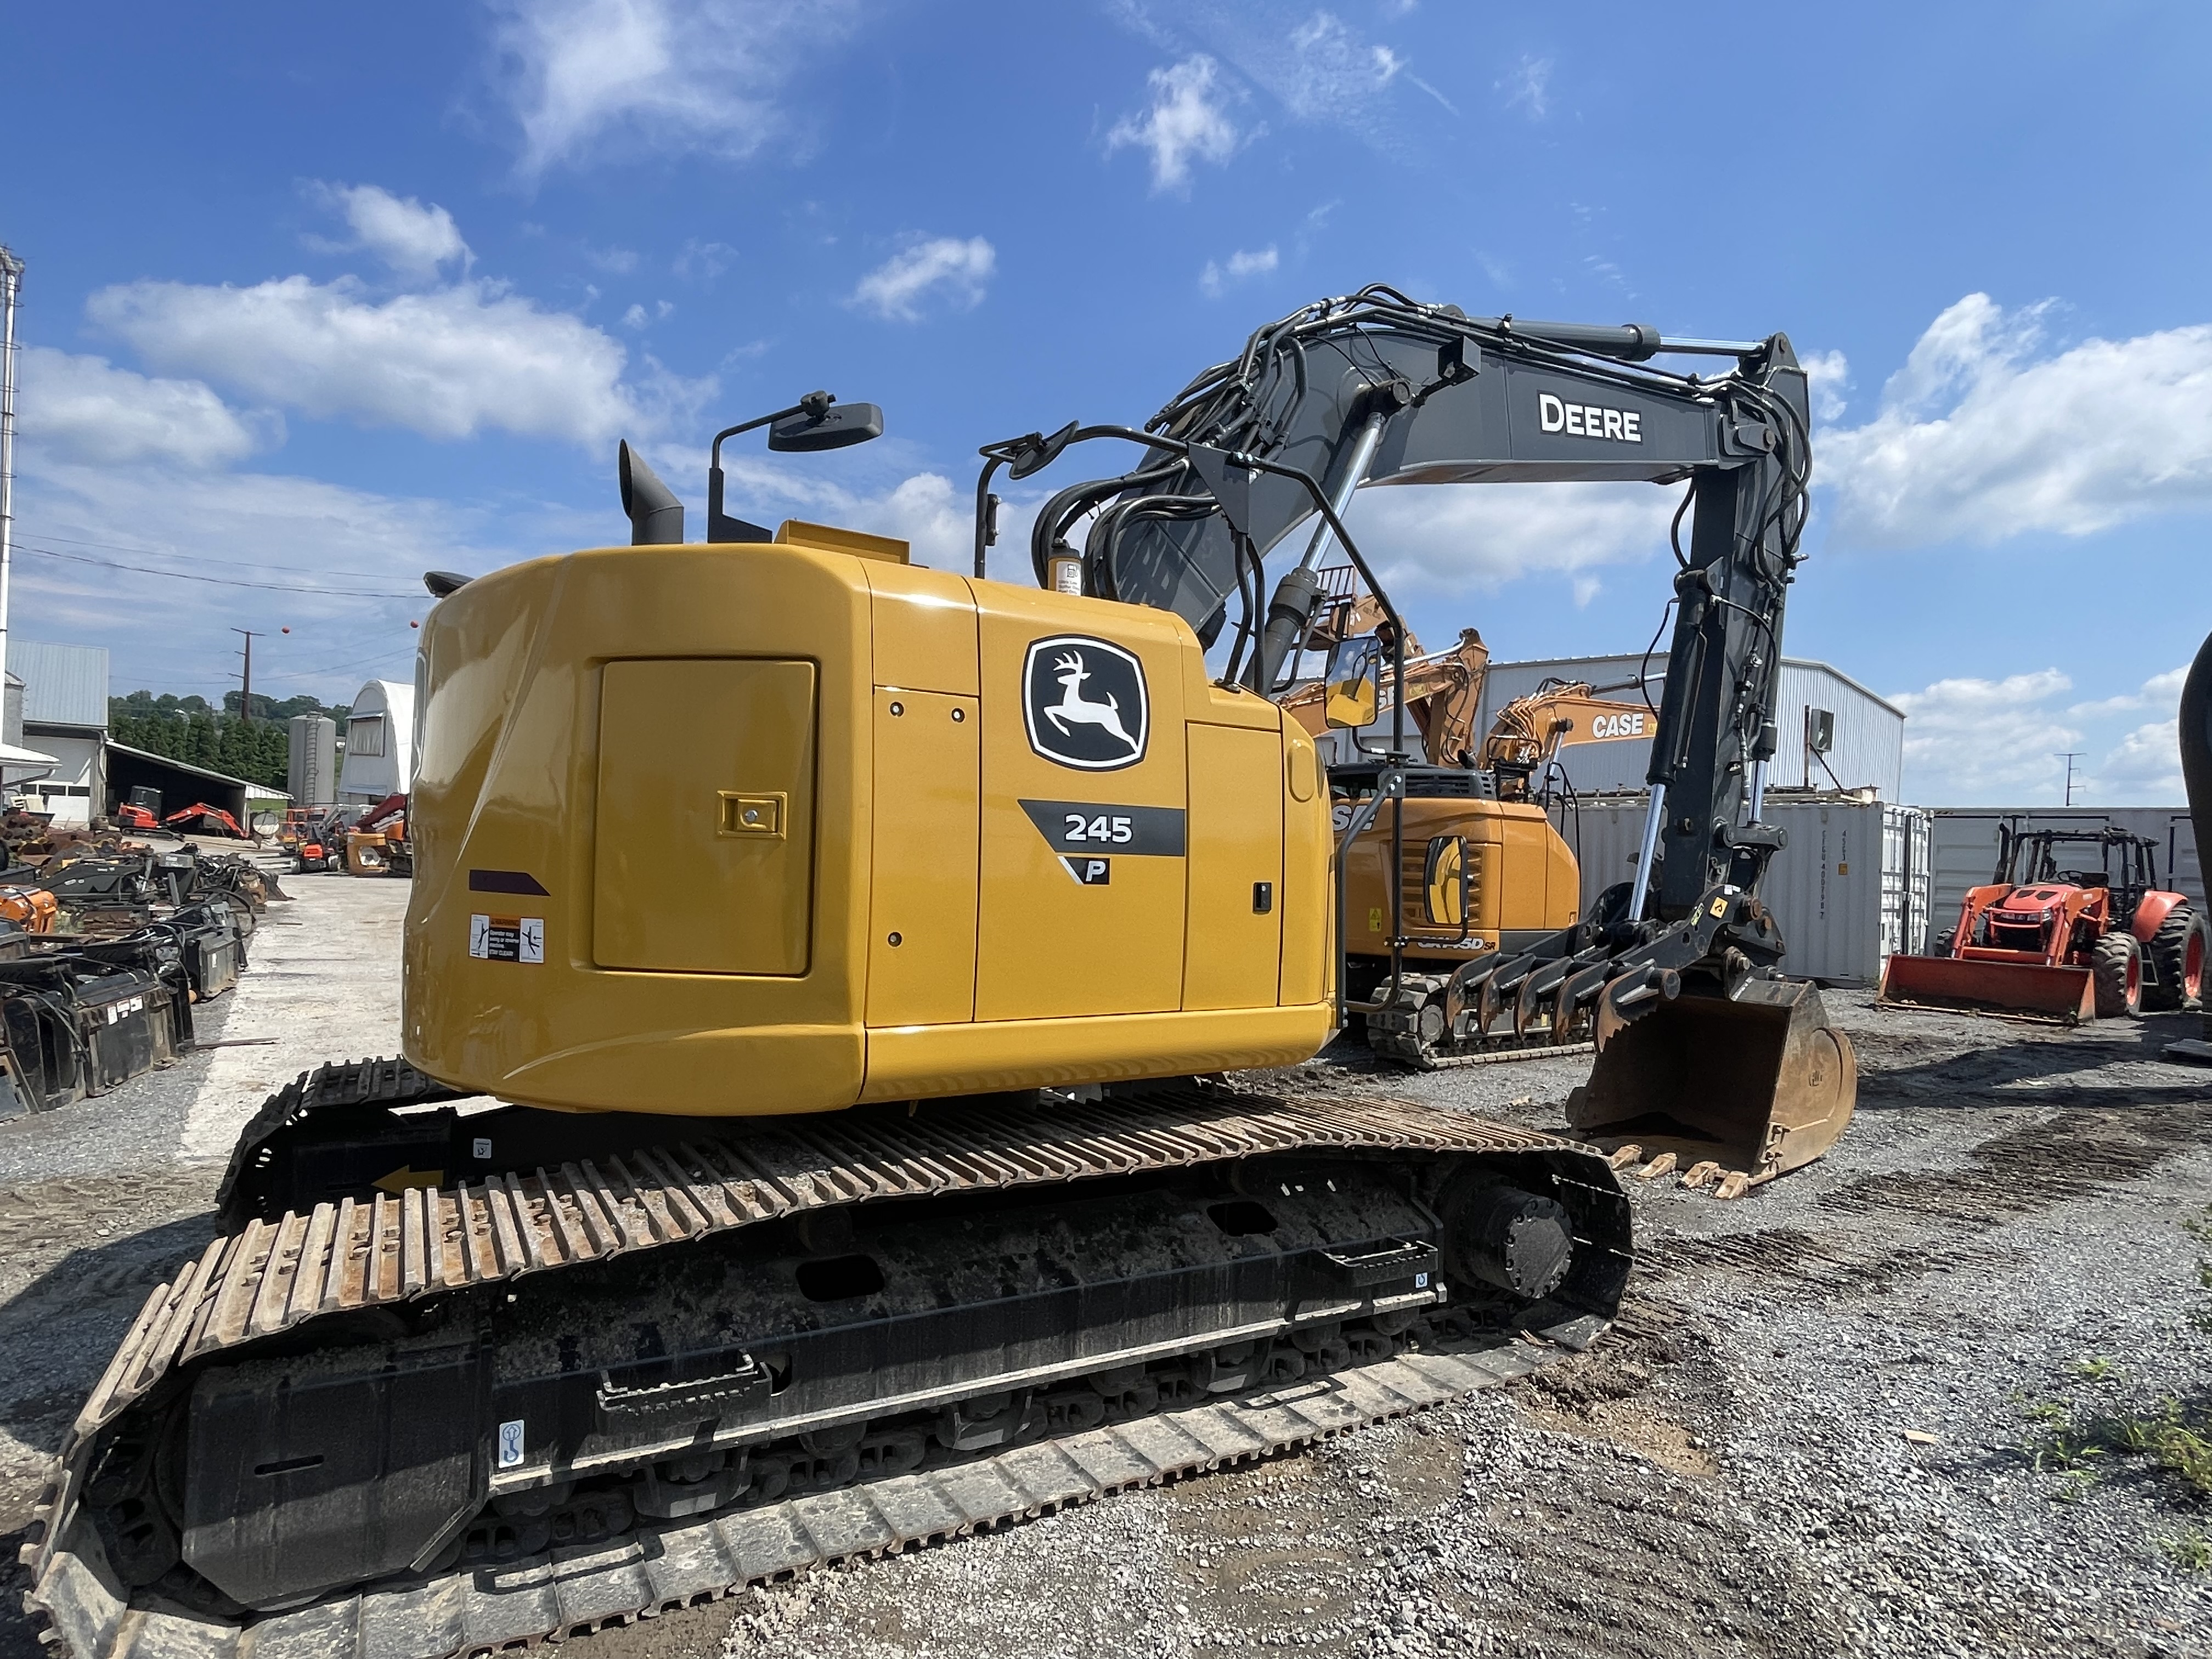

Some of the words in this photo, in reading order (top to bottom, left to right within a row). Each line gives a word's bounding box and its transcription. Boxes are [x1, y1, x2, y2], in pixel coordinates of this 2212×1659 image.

[1539, 393, 1641, 442] DEERE
[1593, 713, 1644, 738] CASE
[1065, 815, 1132, 843] 245
[1085, 860, 1106, 882] P
[1483, 942, 1496, 950] SR
